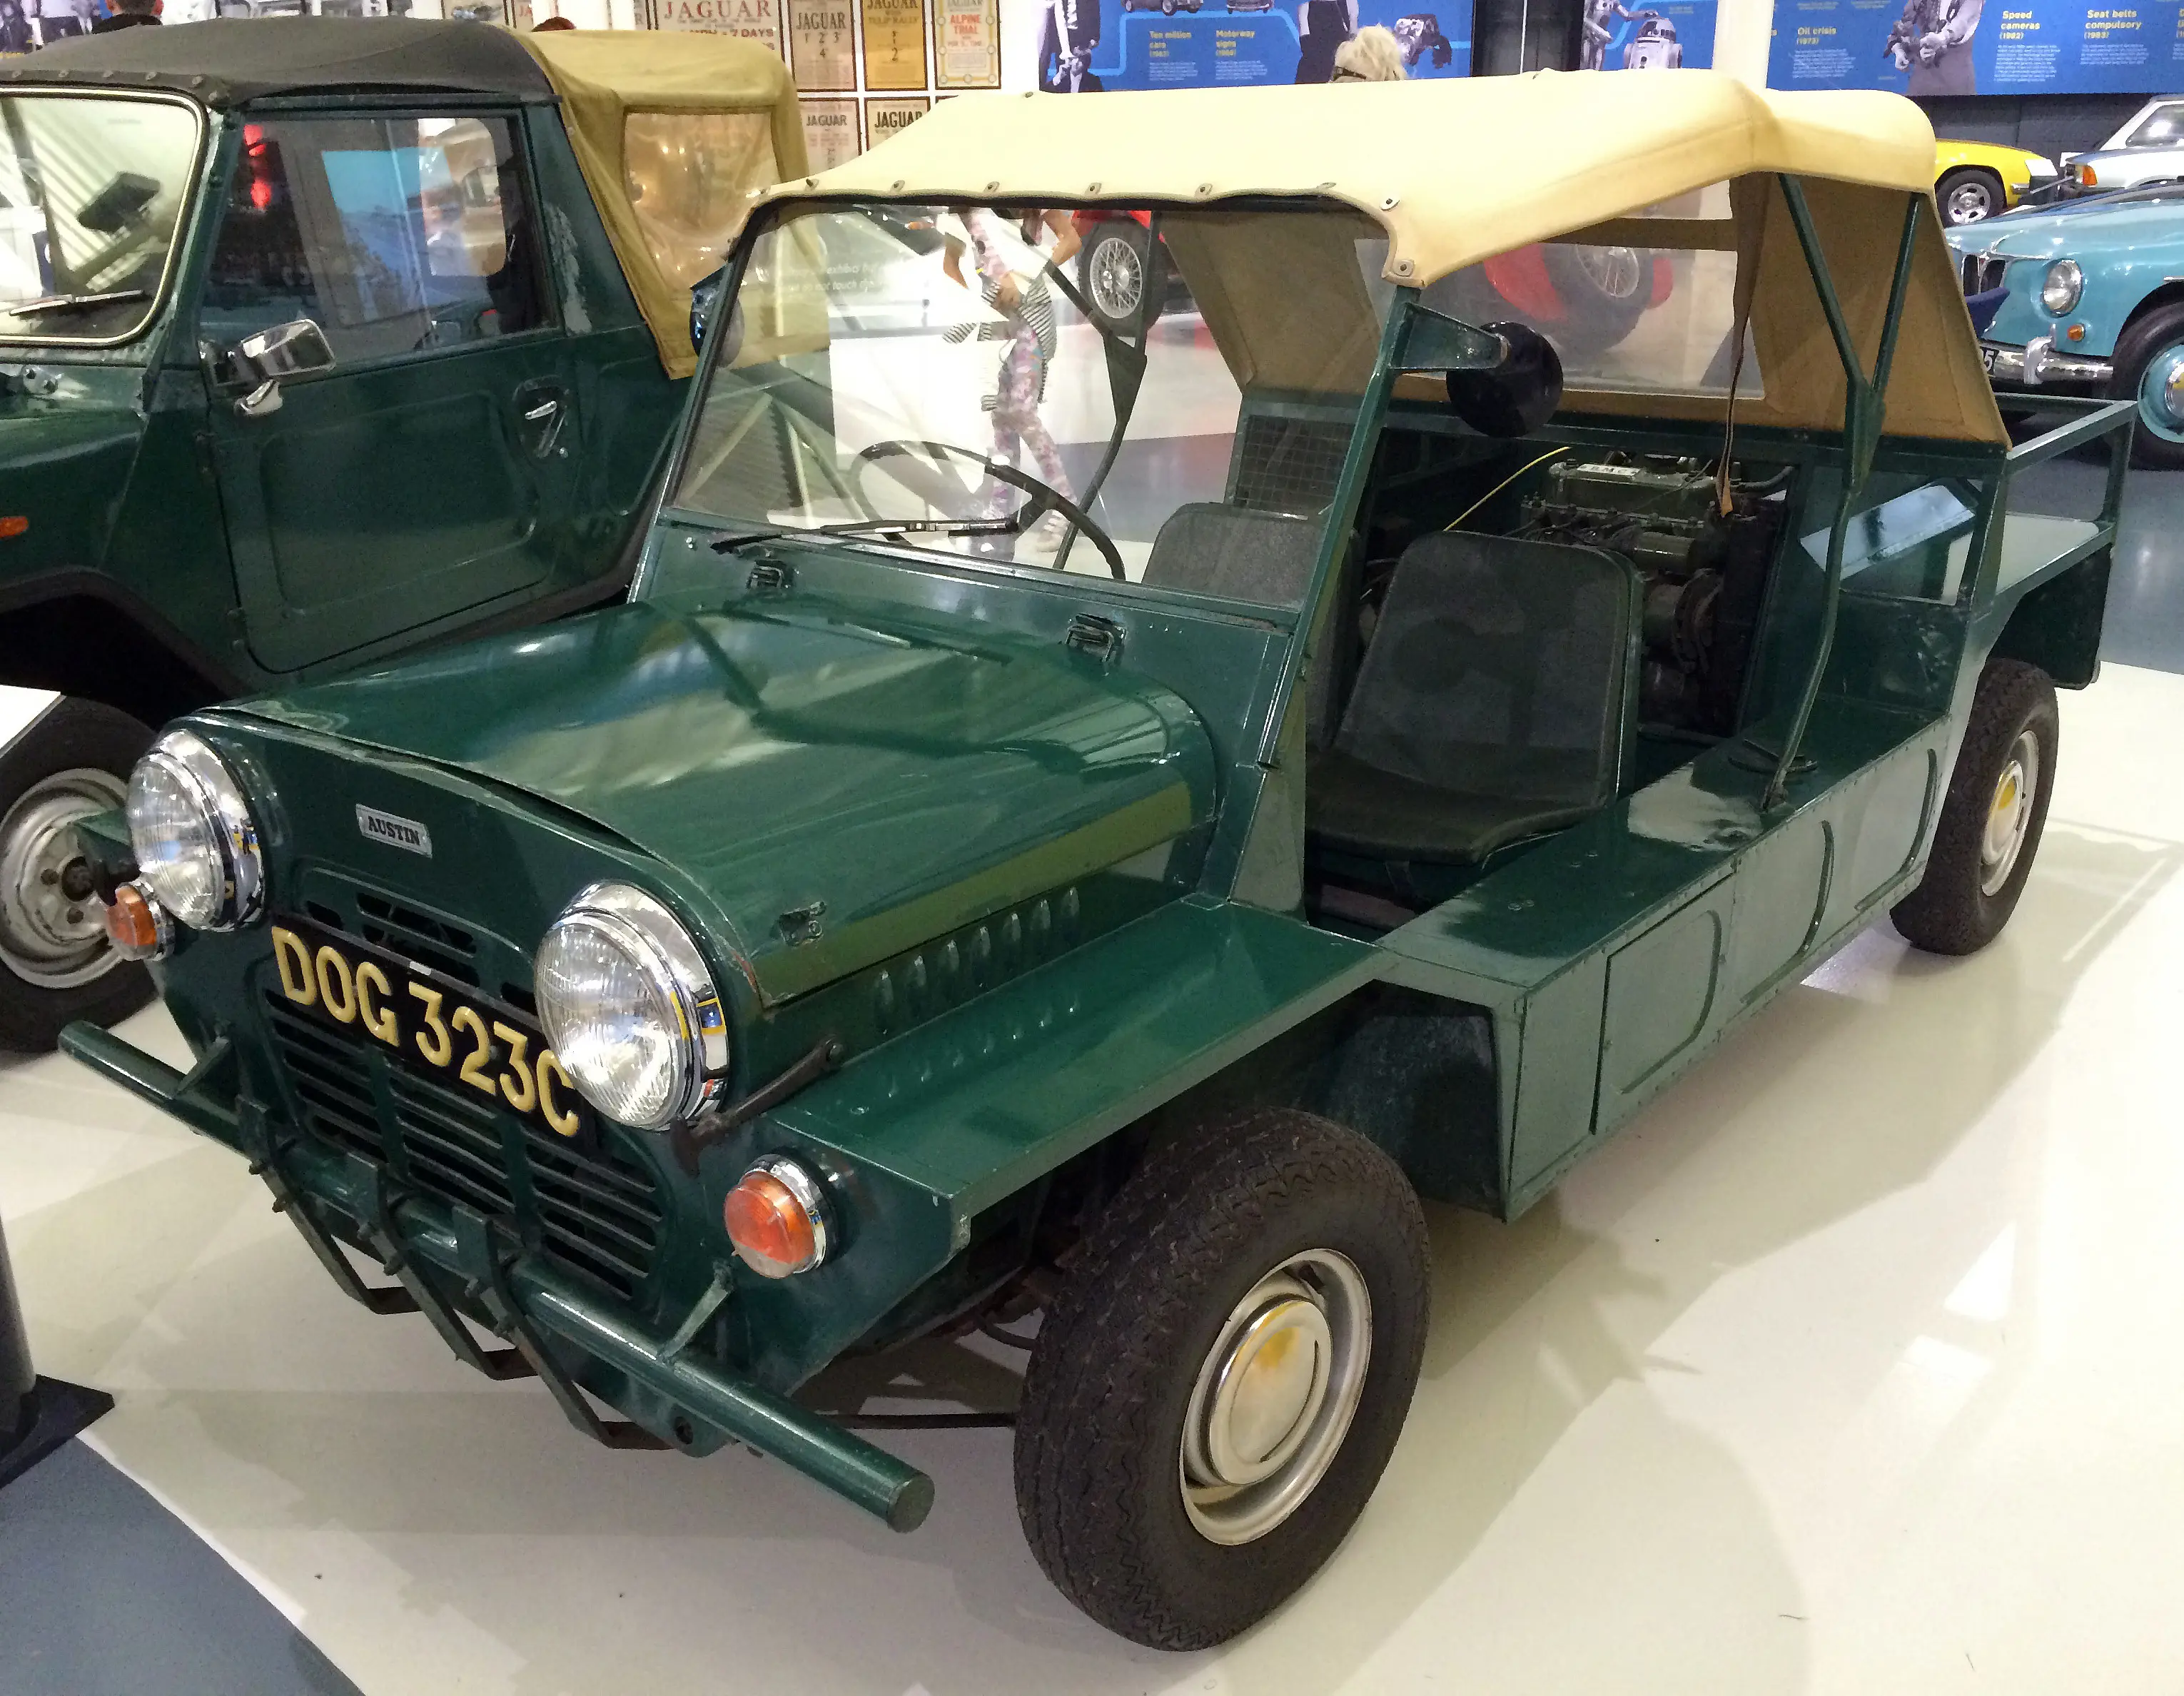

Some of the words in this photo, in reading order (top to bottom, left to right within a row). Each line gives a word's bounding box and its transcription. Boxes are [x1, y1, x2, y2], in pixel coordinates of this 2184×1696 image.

[664, 0, 772, 19] JAGUAR
[2087, 9, 2109, 19] Seat
[2112, 9, 2137, 19] belts
[950, 14, 981, 24] ALPINE
[2002, 10, 2033, 20] Speed
[796, 11, 846, 30] JAGUAR
[2085, 21, 2142, 30] compulsory
[741, 29, 774, 38] DAYS
[1797, 26, 1811, 36] Oil
[1812, 26, 1837, 35] crisis
[806, 114, 848, 127] JAGUAR
[368, 815, 421, 847] AUSTIN
[271, 927, 400, 1047] DOG
[408, 981, 582, 1138] 323C
